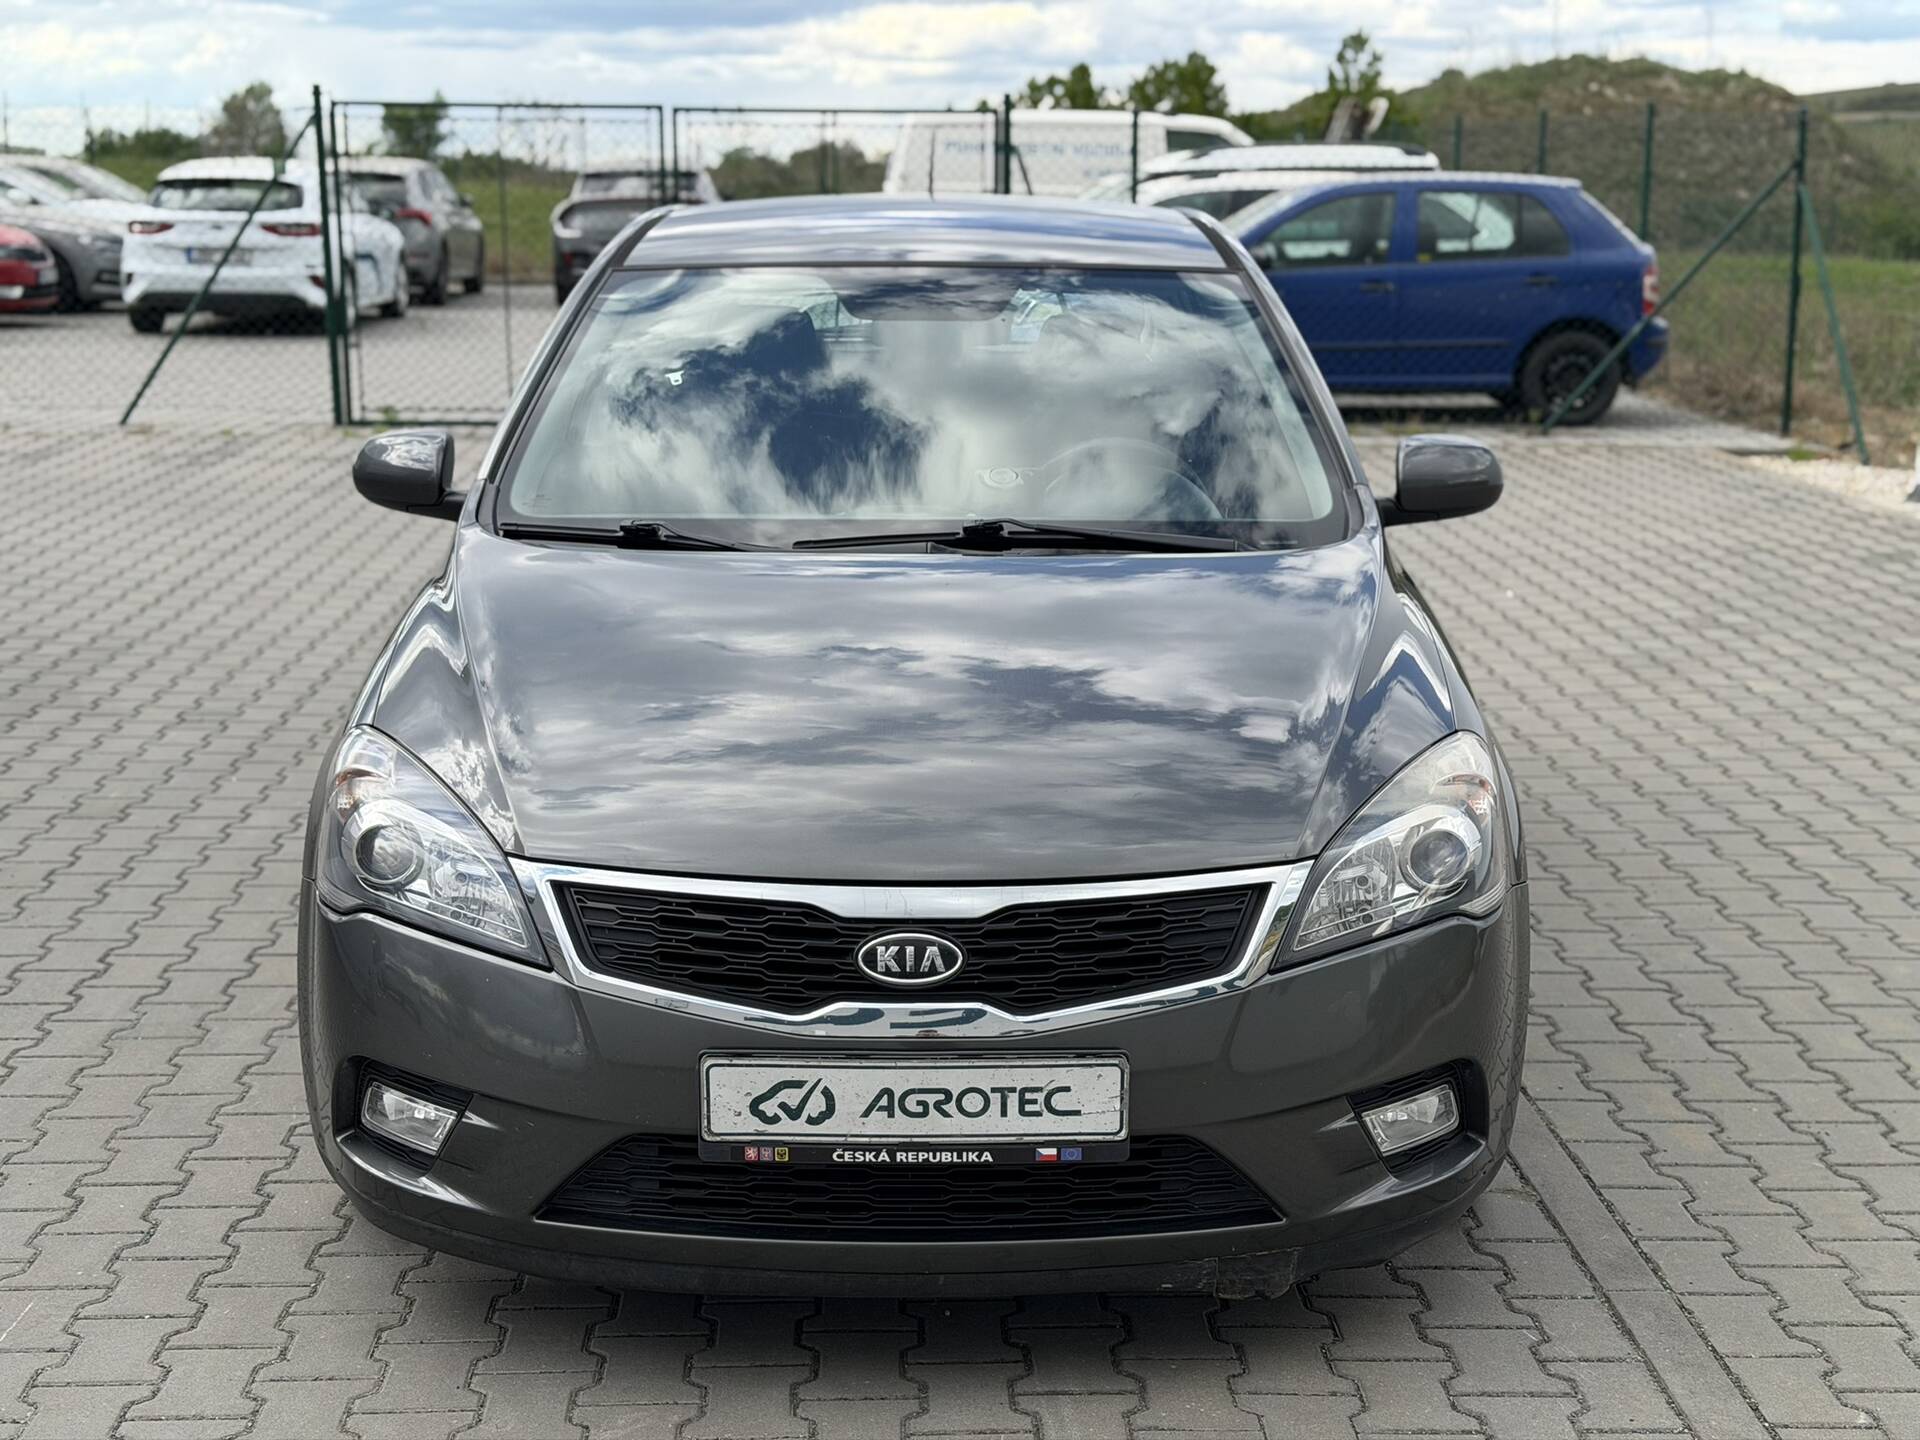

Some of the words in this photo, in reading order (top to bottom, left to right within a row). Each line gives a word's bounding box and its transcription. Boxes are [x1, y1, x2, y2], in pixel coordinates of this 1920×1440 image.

[876, 945, 946, 973] KIA
[859, 1085, 1082, 1119] AGROTEC
[832, 1148, 891, 1163] ČESKÁ
[896, 1151, 994, 1163] REPUBLIKA
